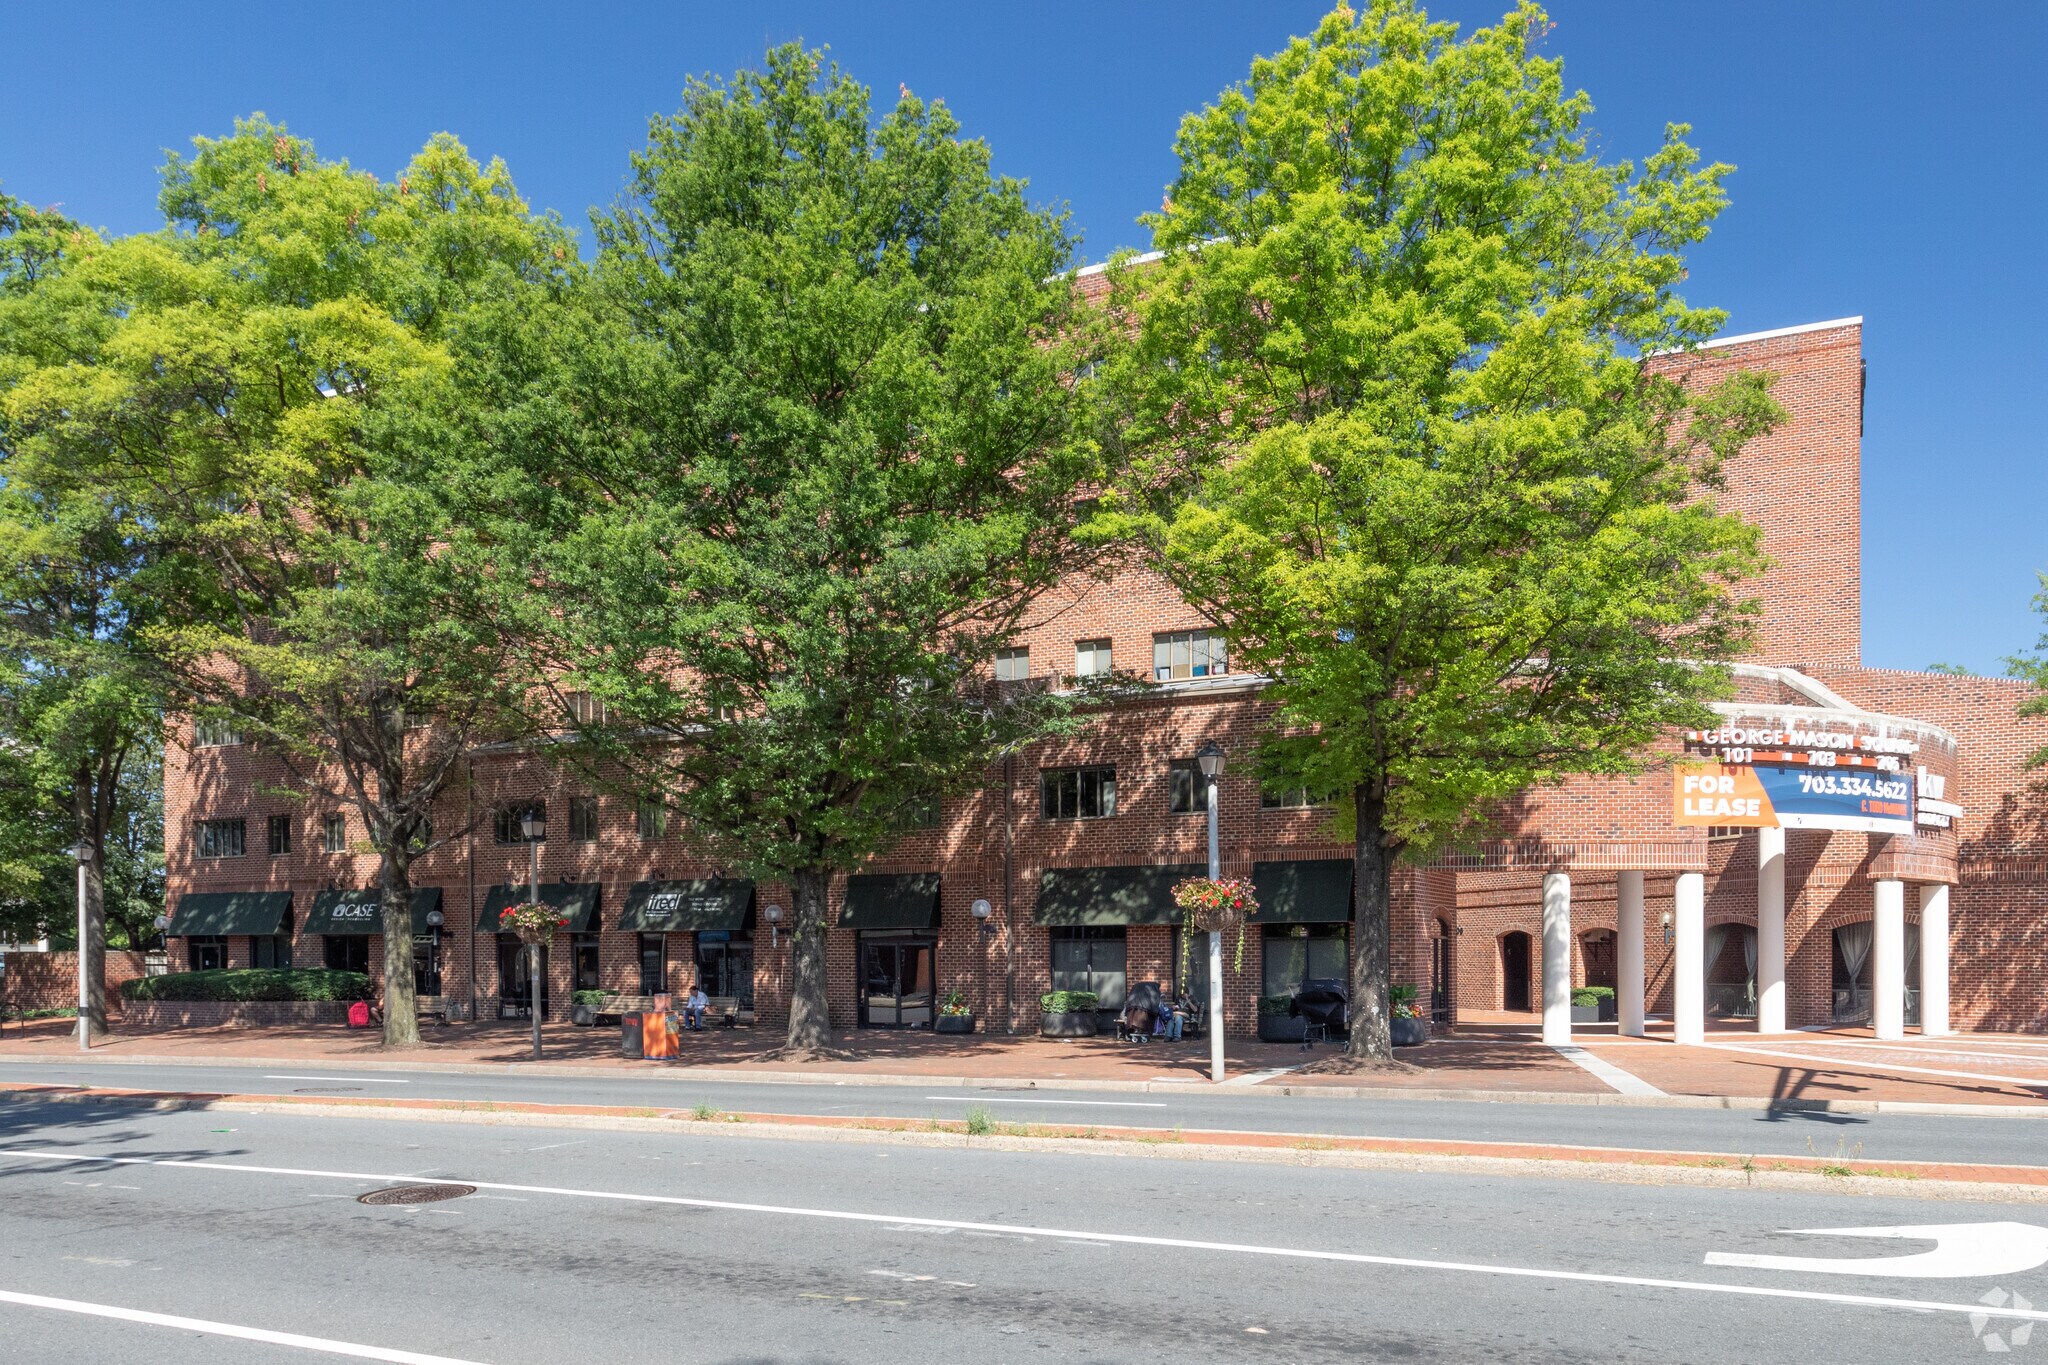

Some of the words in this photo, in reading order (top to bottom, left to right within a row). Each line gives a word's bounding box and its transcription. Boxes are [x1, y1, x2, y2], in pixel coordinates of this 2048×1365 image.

[1702, 729, 1784, 745] GEORGE
[1789, 730, 1854, 749] MASON
[1722, 748, 1753, 763] 101
[1807, 751, 1836, 767] 703
[1684, 776, 1735, 794] FOR
[1799, 774, 1907, 801] 703.334.5622
[1684, 798, 1760, 816] LEASE
[345, 904, 377, 917] CASE
